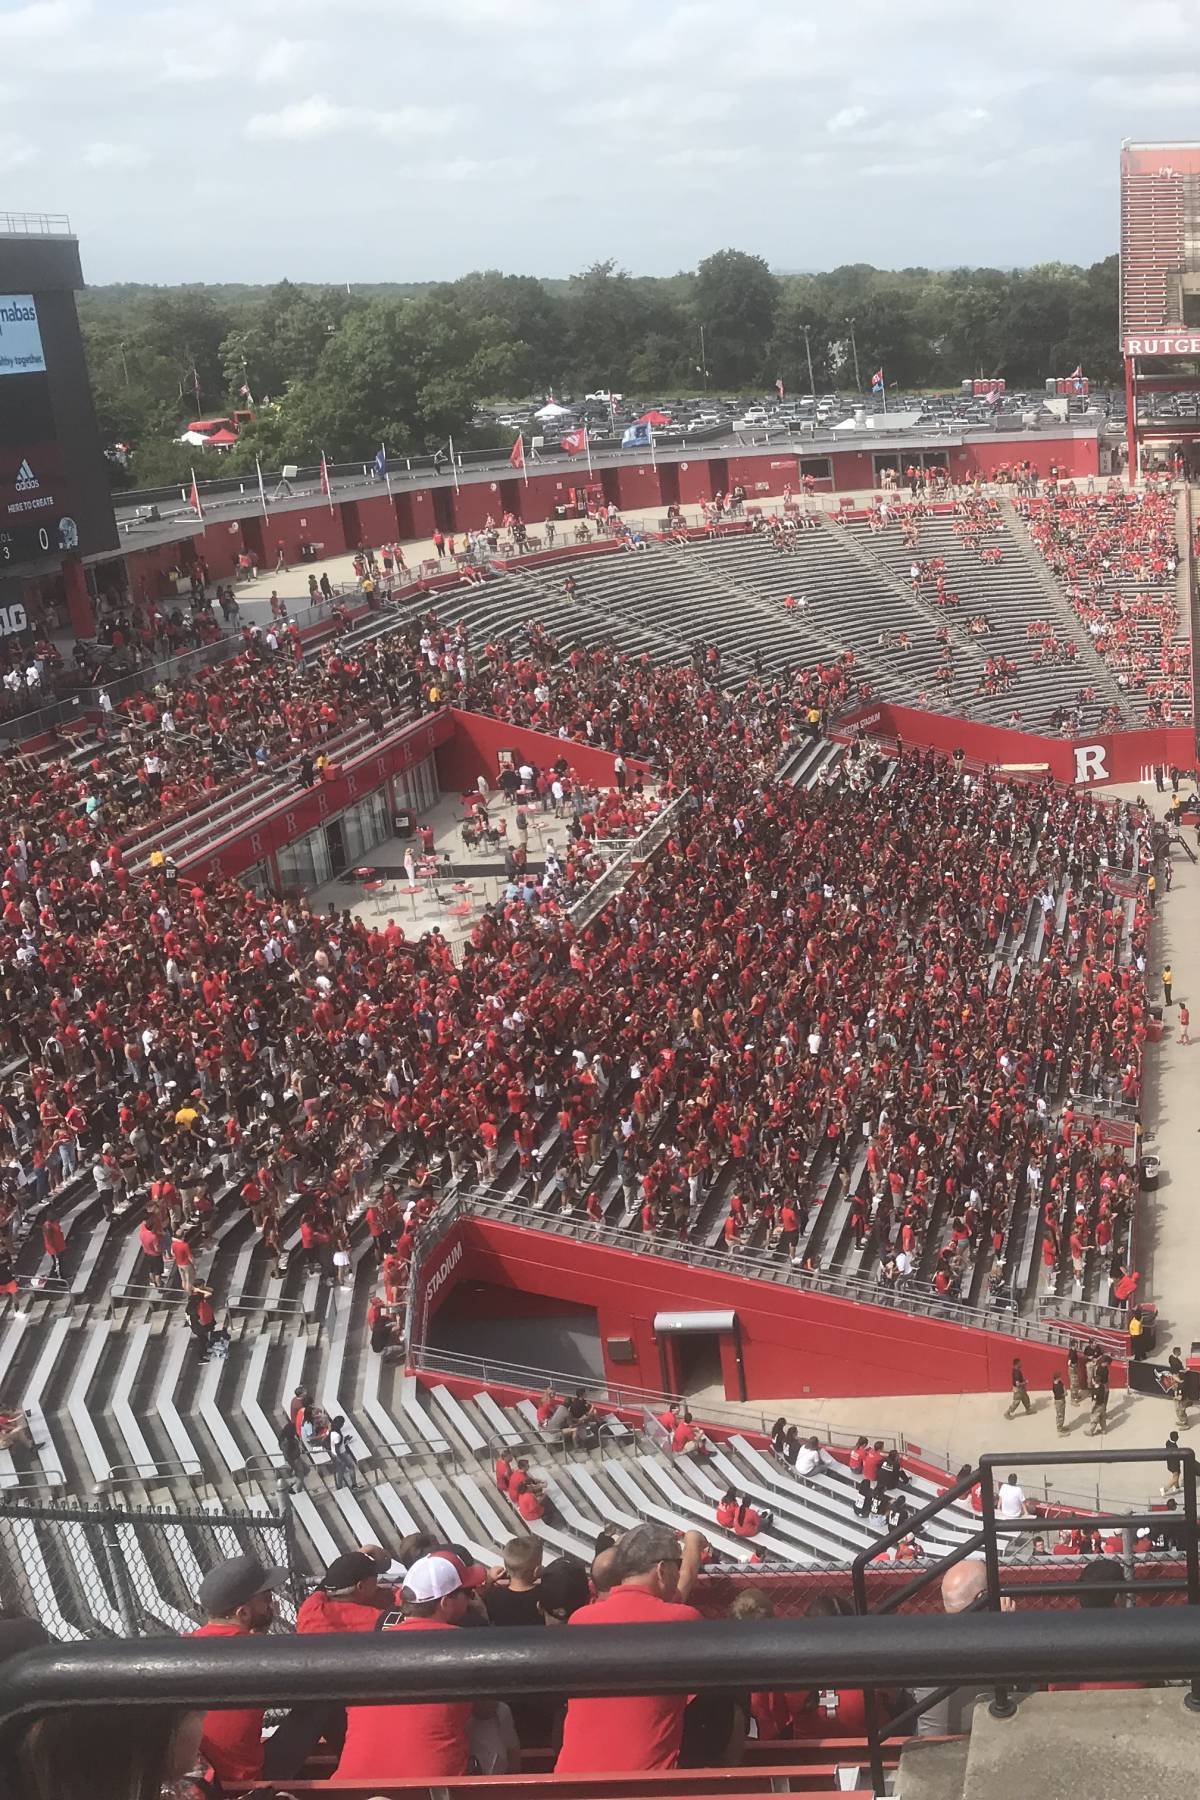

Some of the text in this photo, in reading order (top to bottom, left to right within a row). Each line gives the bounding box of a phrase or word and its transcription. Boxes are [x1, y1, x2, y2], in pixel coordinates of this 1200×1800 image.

[0, 301, 36, 322] nabas
[15, 479, 40, 492] adidas
[7, 496, 55, 514] HERE TO CREATE
[38, 527, 49, 550] 0
[1073, 744, 1109, 784] R
[426, 1241, 463, 1300] STADIUM
